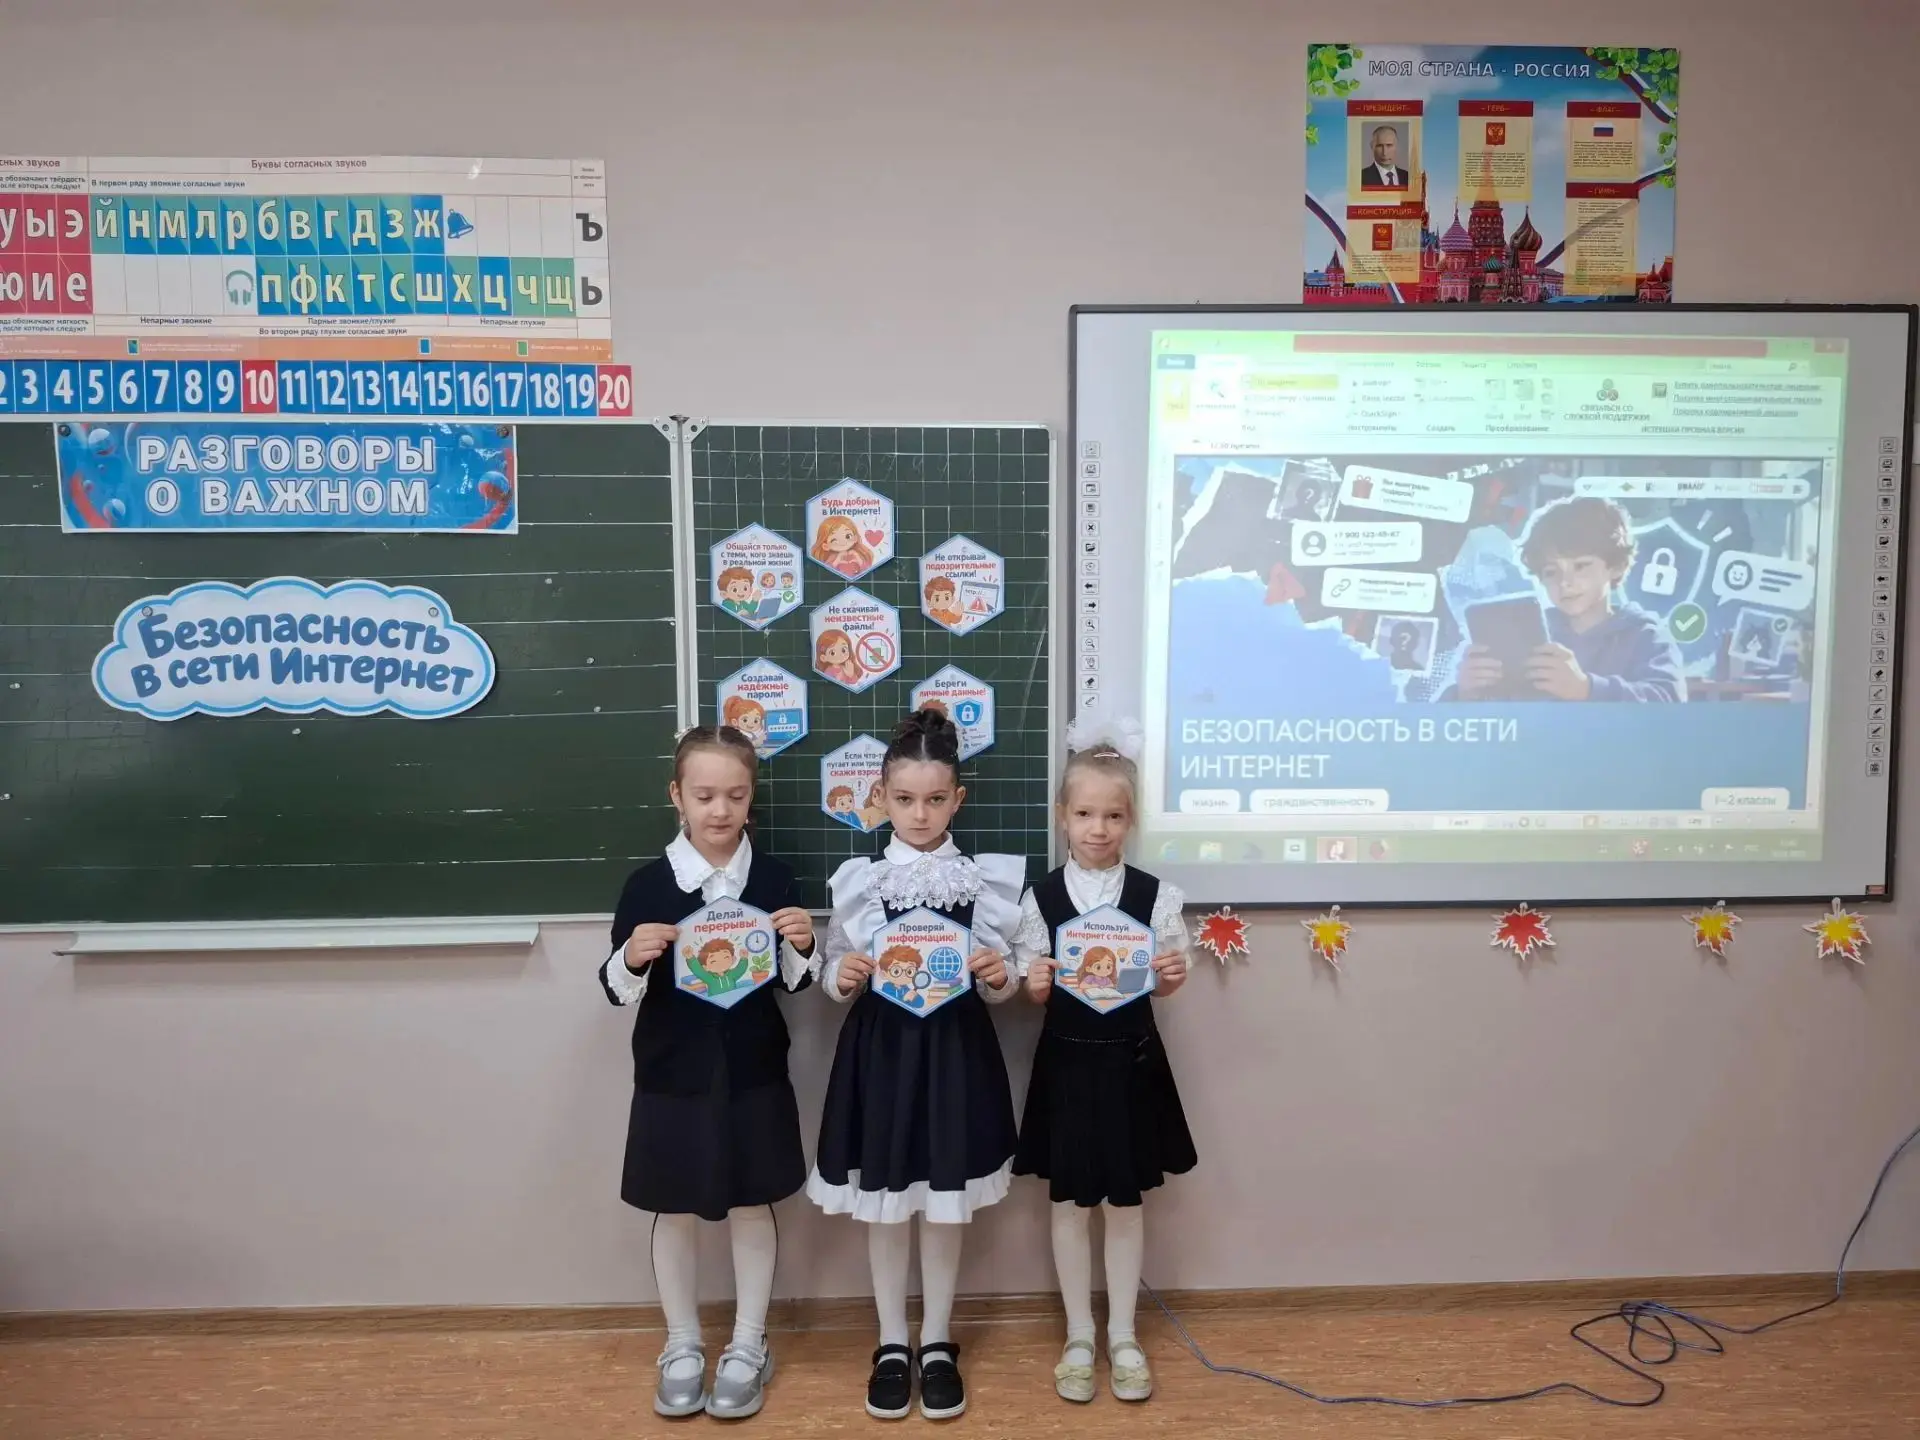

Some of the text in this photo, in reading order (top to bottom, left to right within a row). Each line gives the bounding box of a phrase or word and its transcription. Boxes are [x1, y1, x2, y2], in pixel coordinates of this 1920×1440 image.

[1368, 60, 1413, 77] МОЯ
[1418, 61, 1495, 77] СТРАНА
[1513, 63, 1591, 78] РОССИЯ
[26, 159, 60, 169] звуков
[251, 159, 367, 170] Буквы согласных звуков
[140, 317, 179, 325] Непарные
[308, 317, 337, 325] Парные
[480, 317, 546, 327] Непарные глухие
[300, 329, 318, 337] ряду
[348, 328, 386, 336] согласные
[387, 328, 408, 336] звуки
[21, 369, 631, 409] 3 4 5 6 7 8 9 10 11 12 13 14 15 16 17 18 19 20
[138, 436, 435, 473] РАЗГОВОРЫ
[146, 479, 427, 515] О ВАЖНОМ
[821, 497, 880, 508] Будь добрым
[829, 507, 881, 518] Интернете!
[726, 543, 760, 551] Общайся
[947, 553, 986, 562] открывай
[729, 559, 766, 567] реальной
[926, 562, 997, 571] подозрительные
[945, 570, 977, 578] ссылки!
[828, 604, 879, 614] Не скачивай
[824, 614, 884, 623] неизвестные
[842, 622, 875, 632] файлы!
[137, 613, 451, 659] Безопасность
[130, 647, 474, 698] в сети Интернет
[741, 673, 784, 683] Создавай
[935, 680, 967, 689] Береги
[747, 691, 784, 700] пароли!
[951, 688, 986, 697] данные!
[1181, 718, 1518, 744] БЕЗОПАСНОСТЬ В СЕТИ
[844, 751, 884, 760] Если что-т
[1180, 754, 1331, 779] ИНТЕРНЕТ
[707, 908, 744, 922] Делай
[694, 917, 758, 933] перерывы!
[899, 922, 945, 933] Проверяй
[1084, 921, 1129, 933] Используй
[887, 932, 957, 944] информацию!
[1066, 929, 1105, 941] Интернет
[1113, 933, 1148, 942] пользой!
